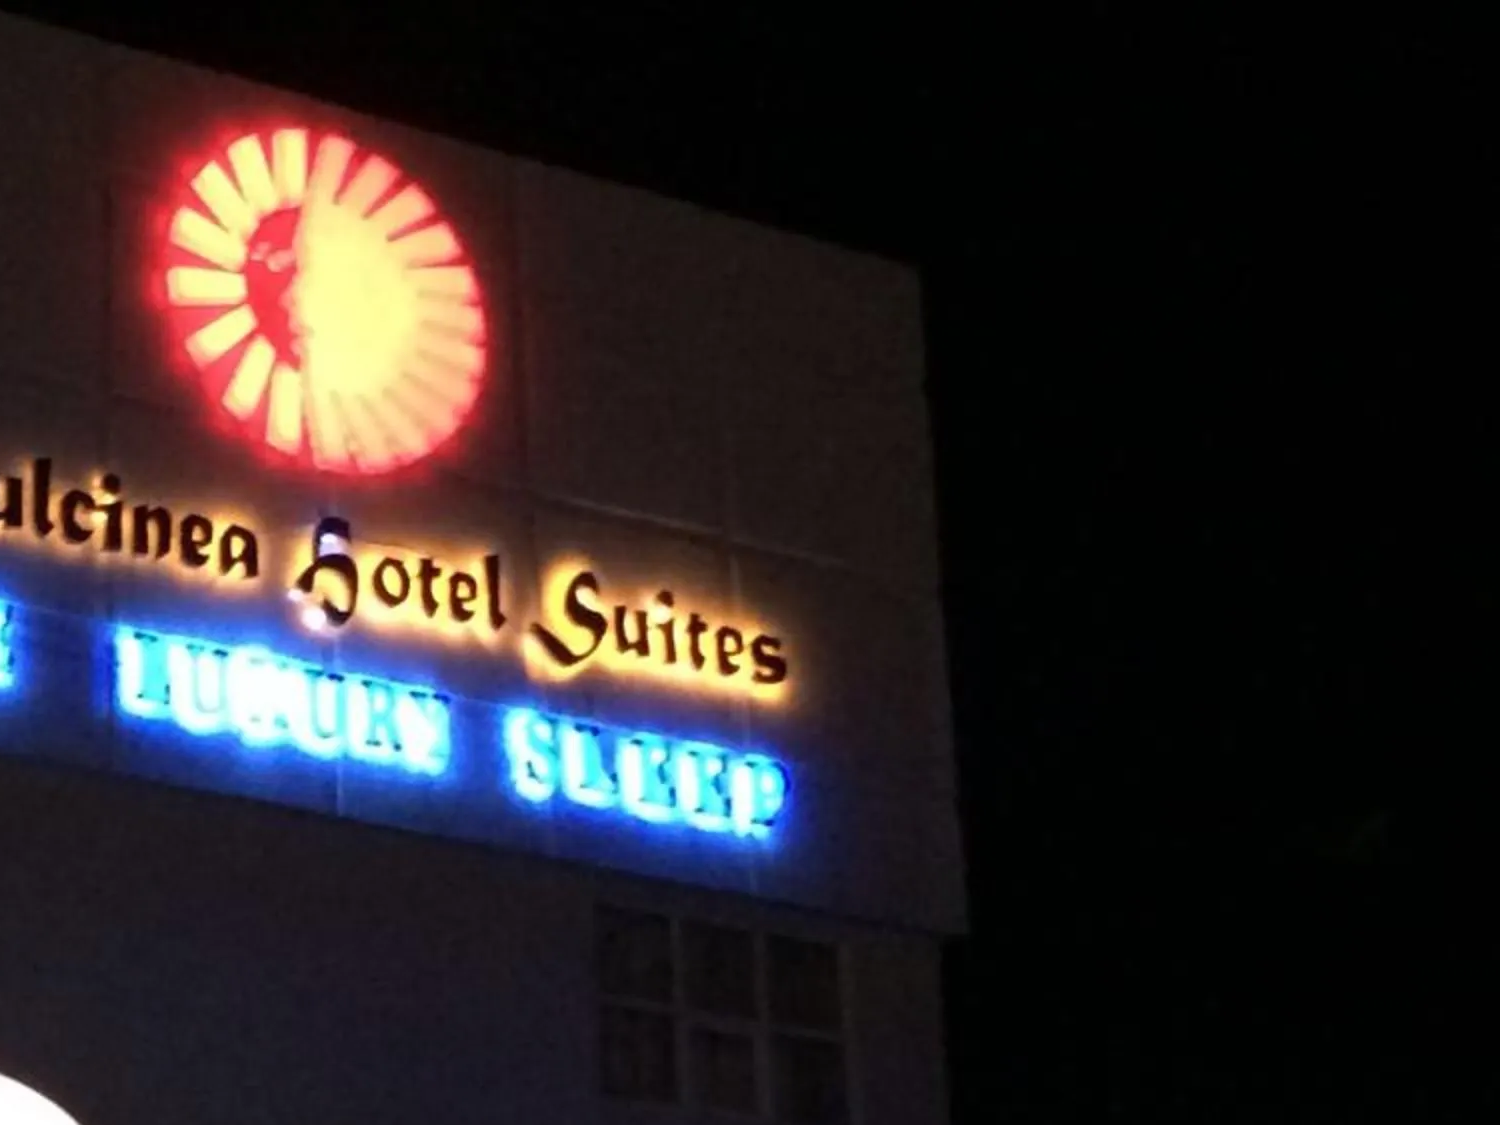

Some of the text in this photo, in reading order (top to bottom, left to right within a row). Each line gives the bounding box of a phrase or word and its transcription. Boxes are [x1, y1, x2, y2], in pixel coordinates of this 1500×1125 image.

[297, 515, 507, 628] Hotel
[529, 572, 788, 686] Suites
[507, 706, 789, 838] SLEEP
